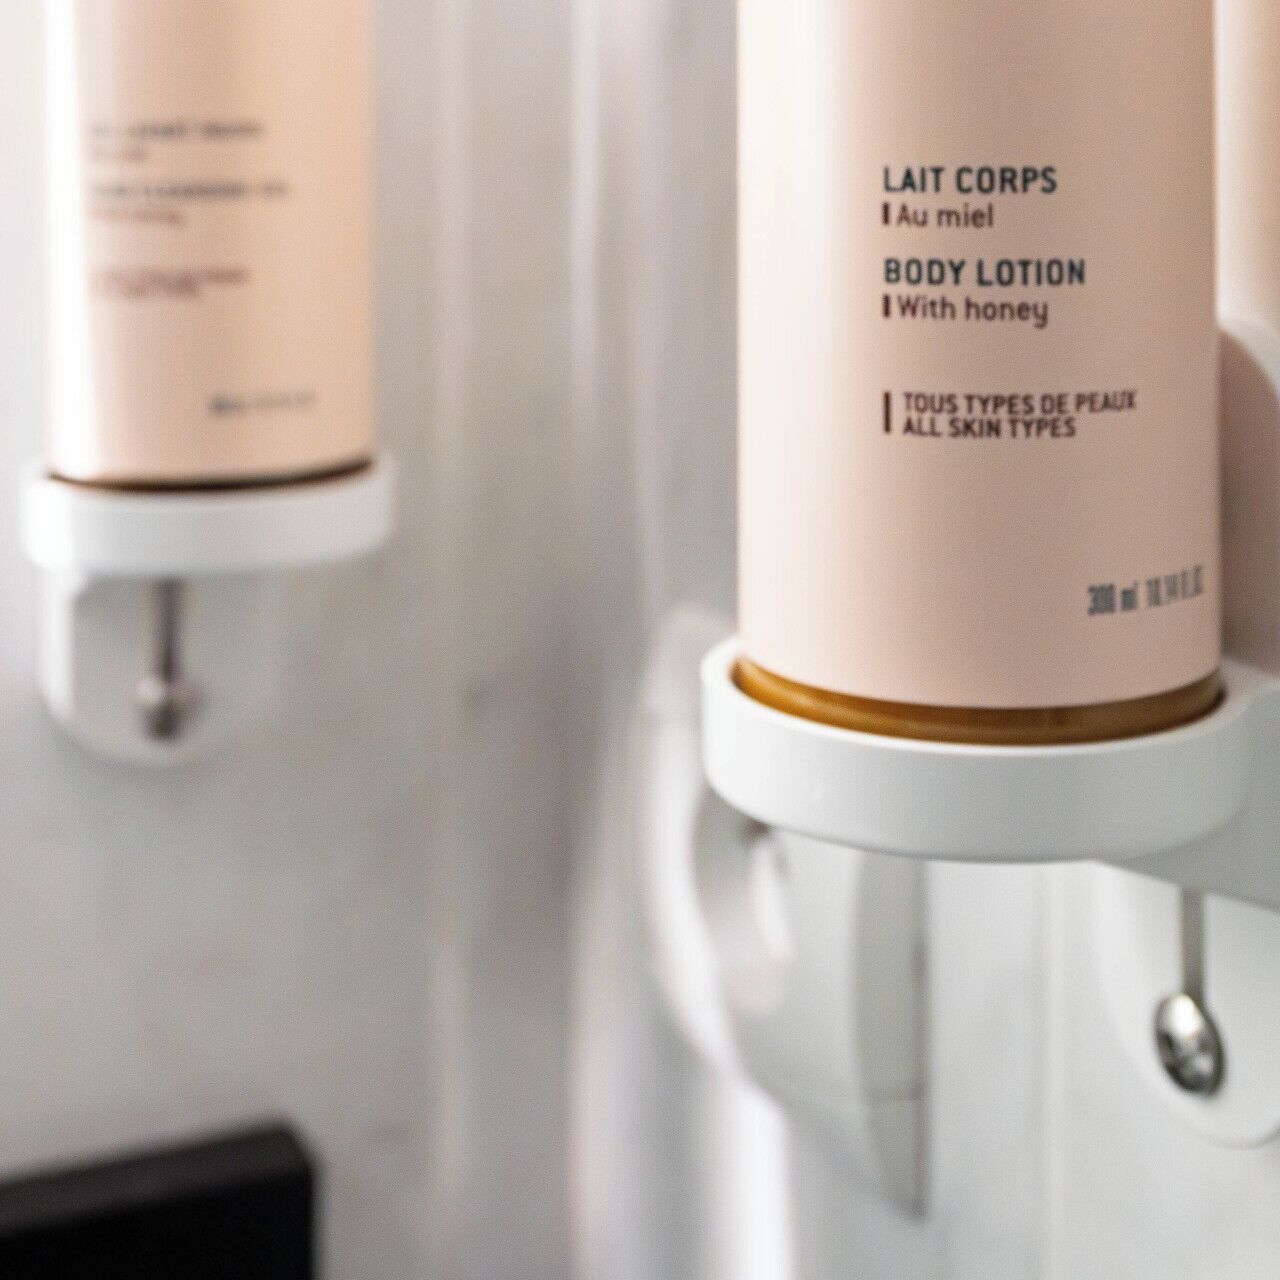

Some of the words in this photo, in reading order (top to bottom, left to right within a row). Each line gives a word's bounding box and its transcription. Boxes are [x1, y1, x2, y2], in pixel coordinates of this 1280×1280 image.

[882, 166, 945, 195] LAIT
[955, 165, 1058, 195] CORPS
[896, 204, 928, 228] Au
[936, 202, 995, 229] miel
[883, 258, 966, 288] BODY
[975, 257, 1086, 288] LOTION
[897, 296, 956, 322] With
[964, 296, 1050, 331] honey
[902, 391, 959, 415] TOUS
[963, 392, 1035, 416] TYPES
[1039, 392, 1071, 415] DE
[1074, 388, 1139, 414] PEAUX
[901, 417, 943, 439] ALL
[948, 418, 1002, 440] SKIN
[1007, 417, 1078, 440] TYPES
